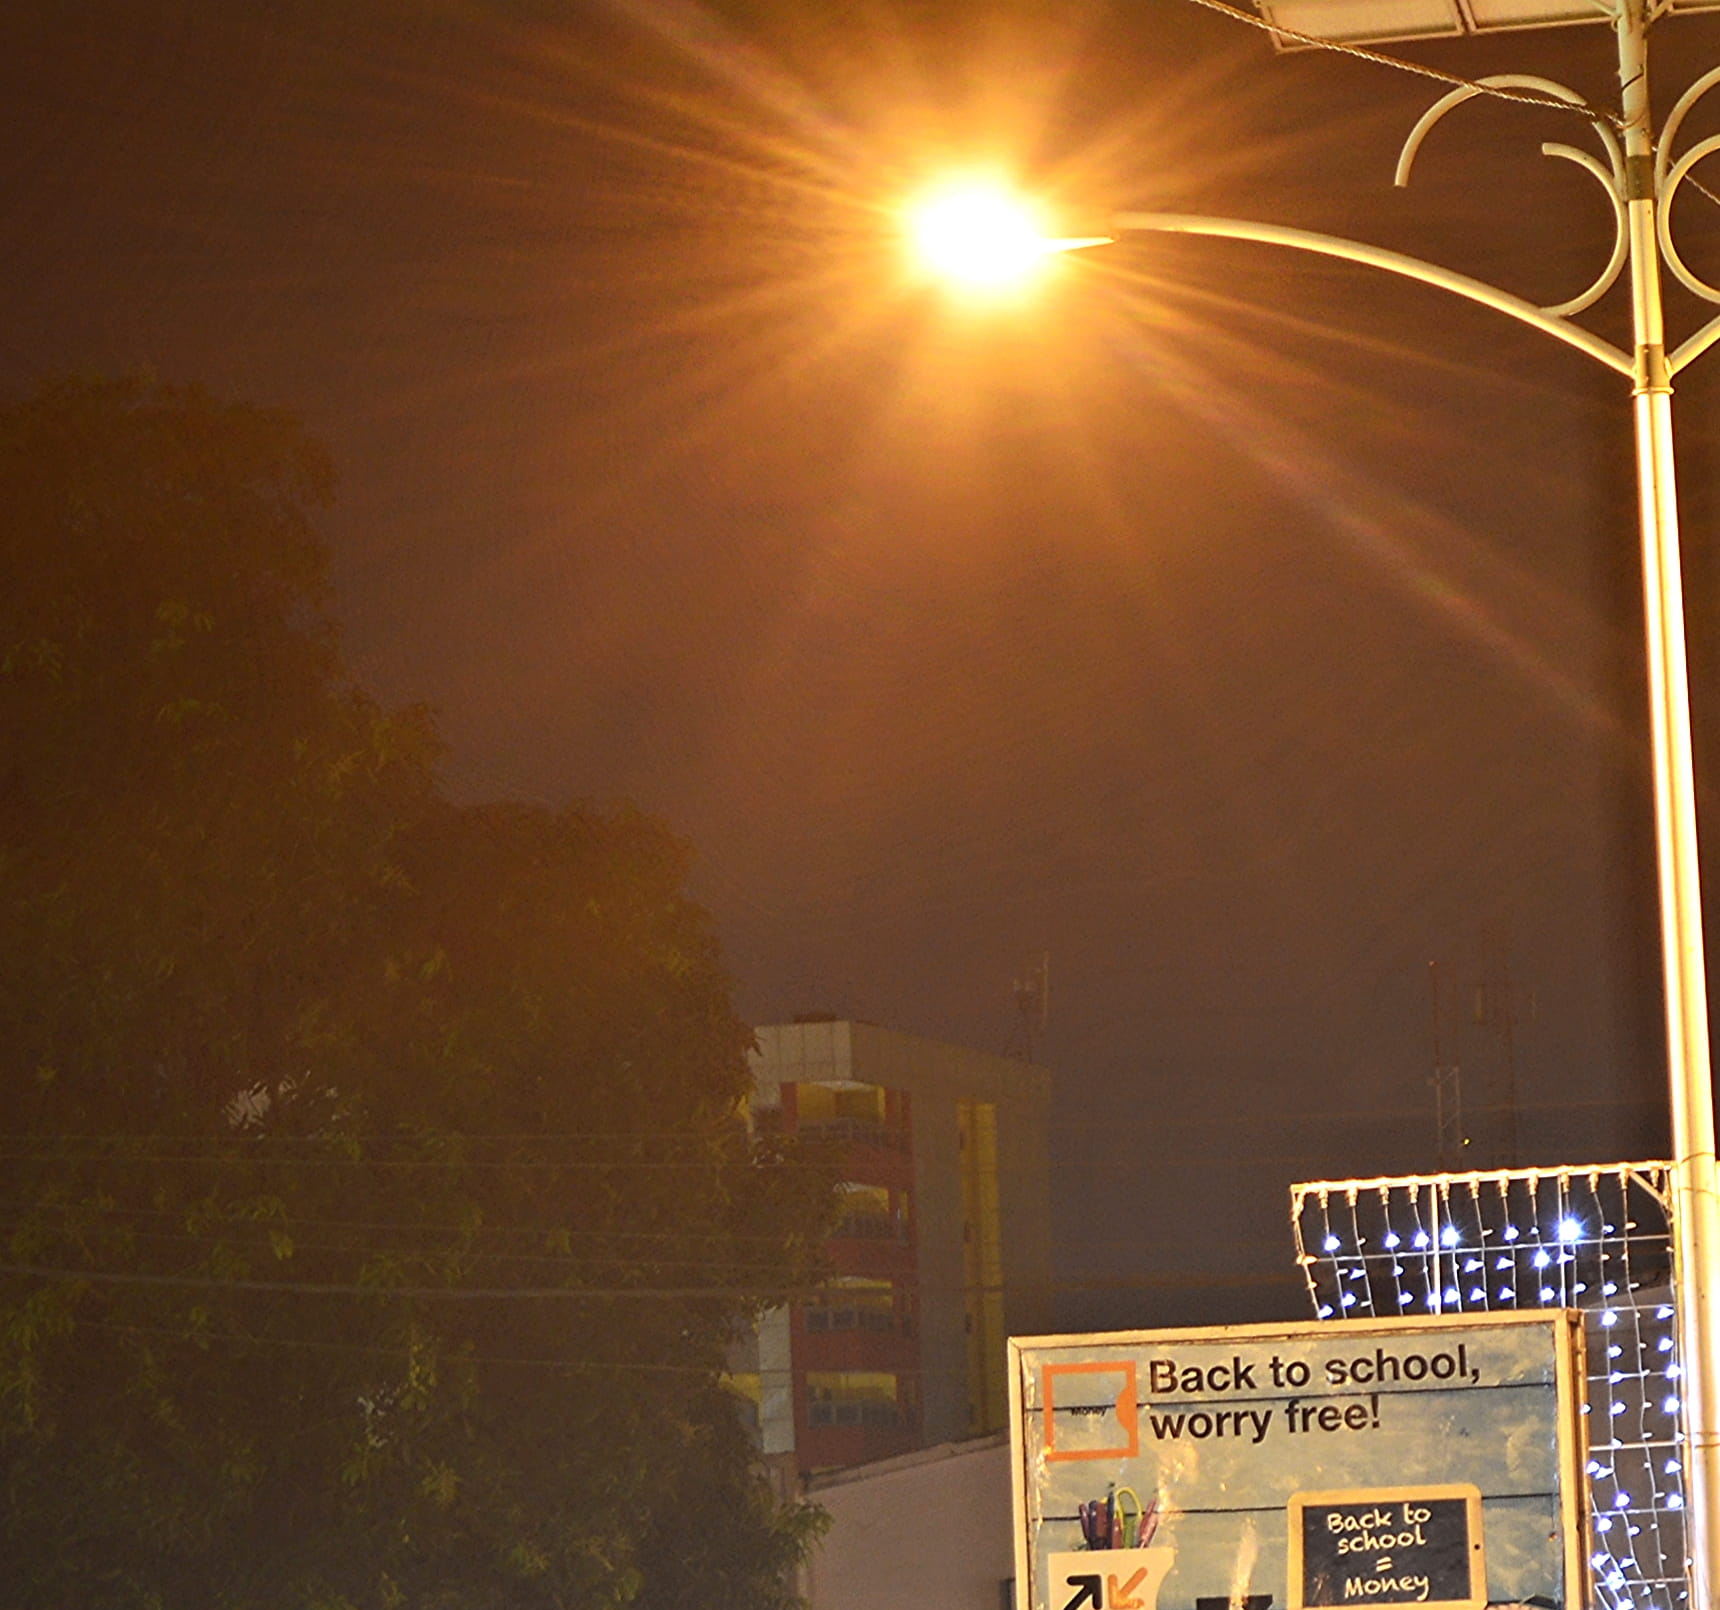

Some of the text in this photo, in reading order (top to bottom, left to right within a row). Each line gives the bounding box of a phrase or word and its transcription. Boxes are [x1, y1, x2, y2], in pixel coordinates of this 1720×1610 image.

[1149, 1344, 1481, 1394] Back to school,
[1149, 1394, 1381, 1444] worry free!
[1327, 1503, 1432, 1534] Back to
[1337, 1524, 1427, 1554] school
[1344, 1576, 1430, 1601] Money
